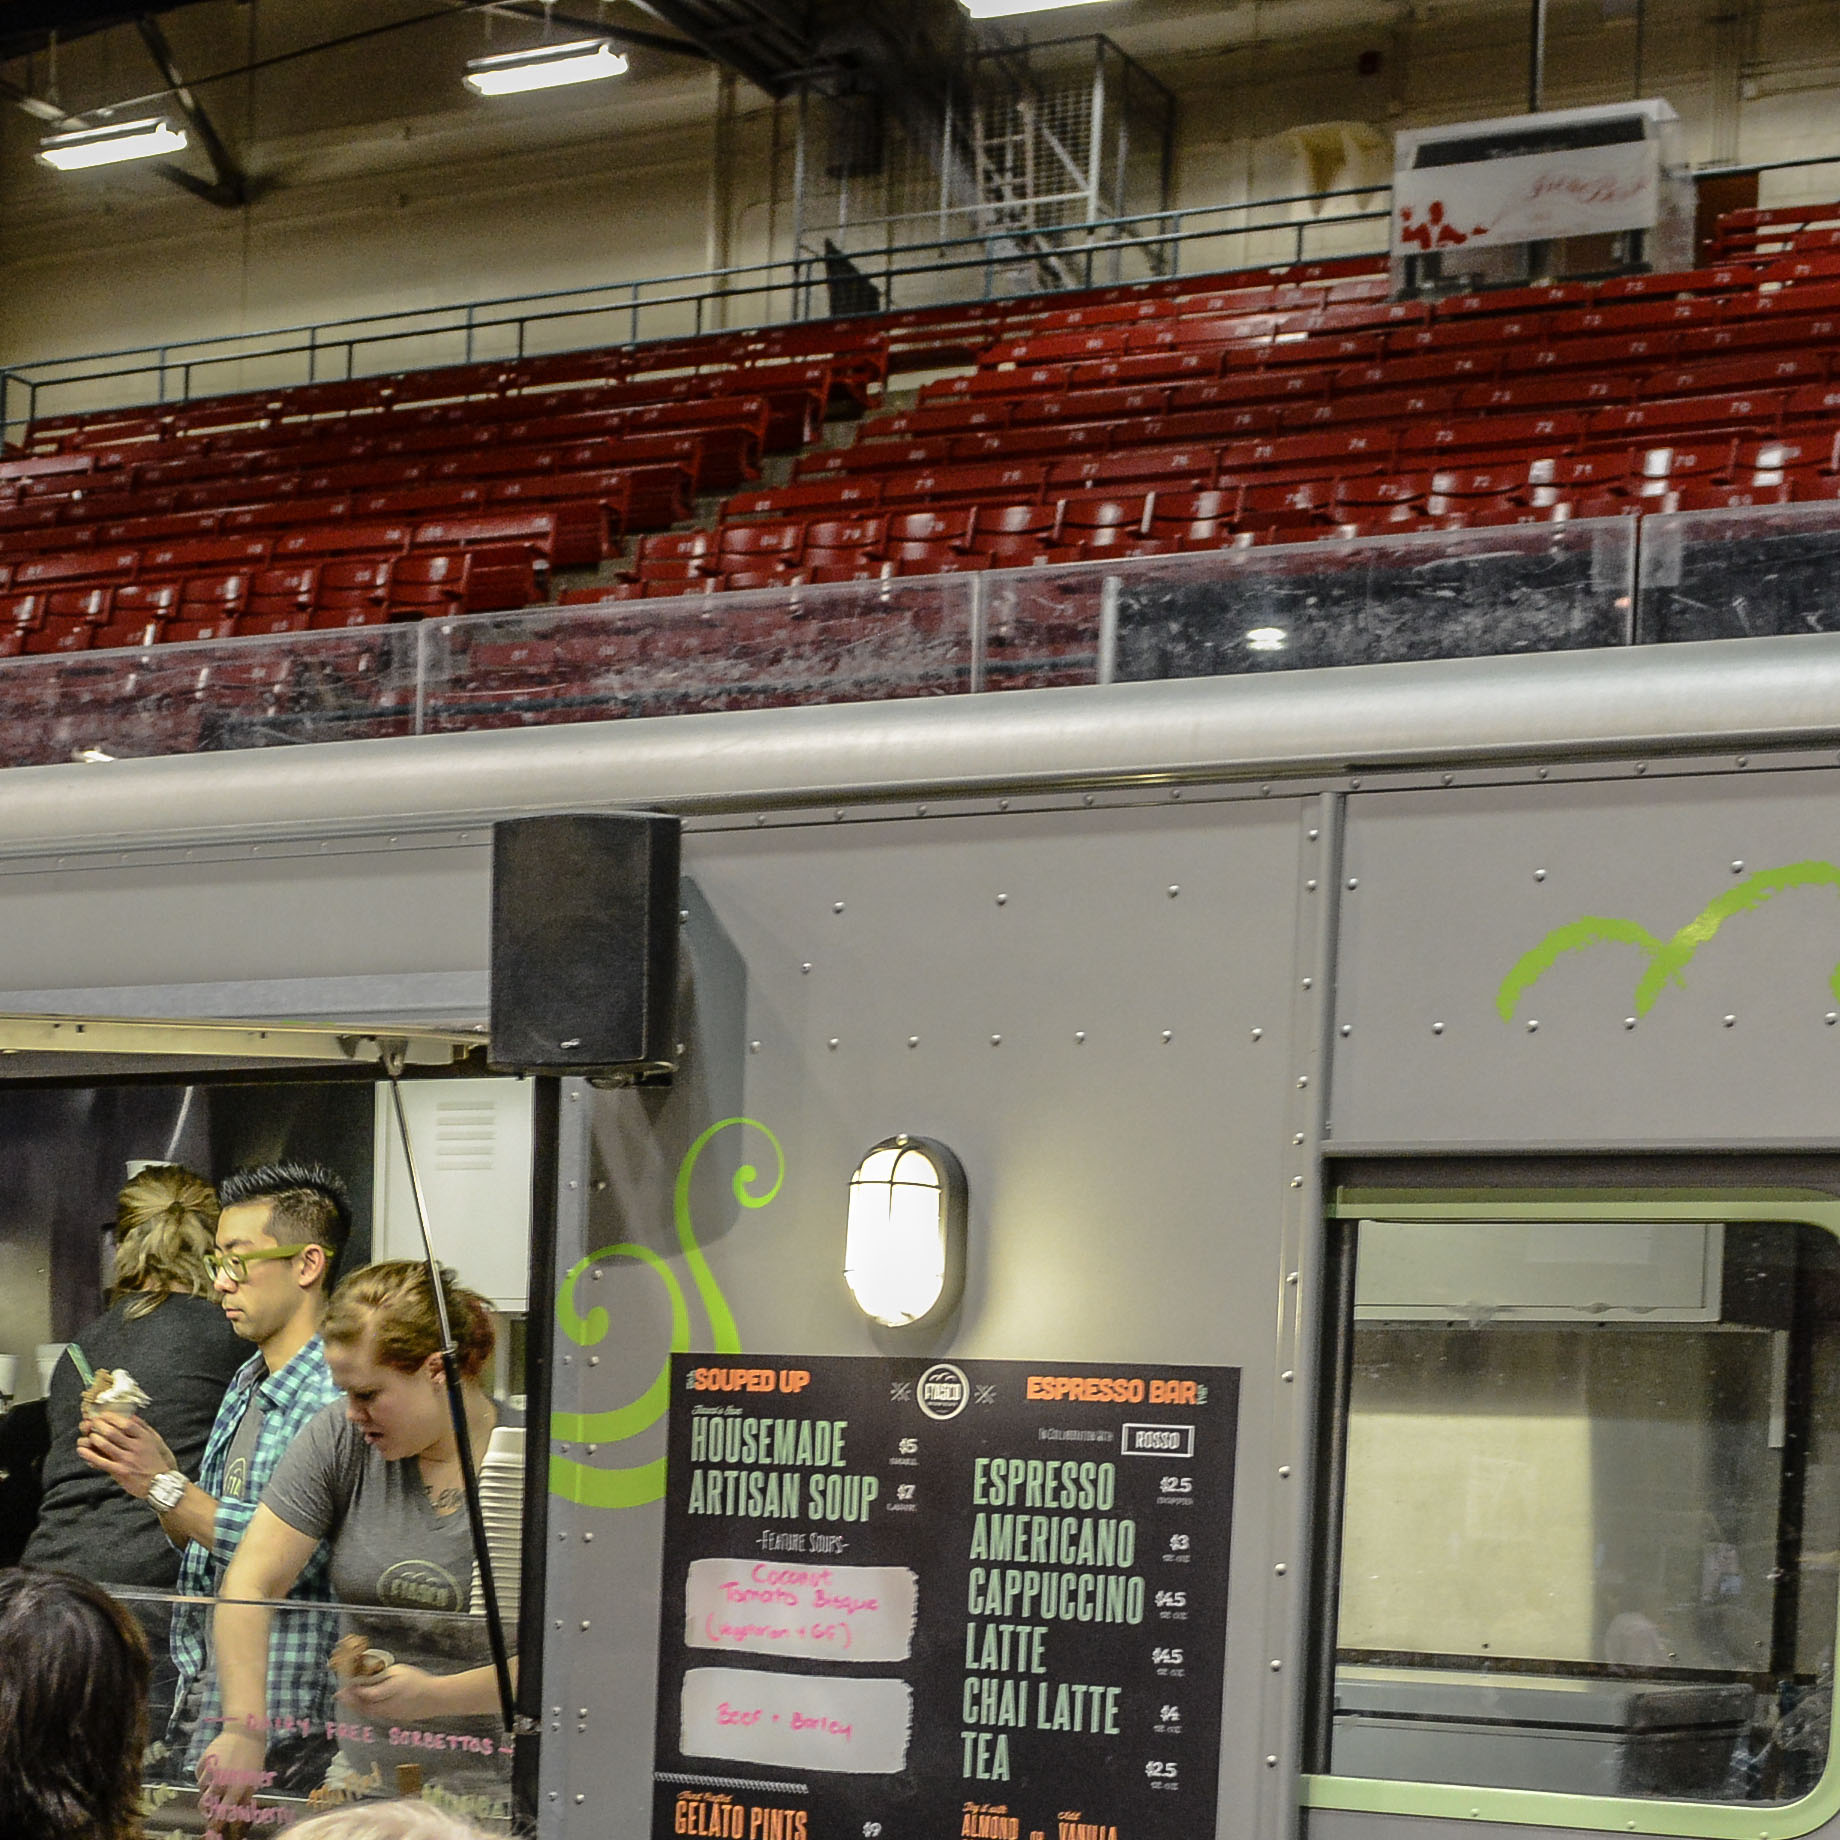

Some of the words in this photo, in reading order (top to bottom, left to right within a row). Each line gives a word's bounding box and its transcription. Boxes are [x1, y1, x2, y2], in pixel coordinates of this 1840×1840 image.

[694, 1367, 777, 1393] SOUPED
[778, 1369, 811, 1394] UP
[1026, 1376, 1146, 1404] ESPRESSO
[1148, 1379, 1199, 1406] BAR
[690, 1415, 849, 1468] HOUSEMADE
[898, 1437, 920, 1455] $5
[1134, 1430, 1182, 1450] ROSSO
[687, 1468, 802, 1519] ARTISAN
[808, 1473, 881, 1523] SOUP
[973, 1457, 1117, 1512] ESPRESSO
[968, 1512, 1137, 1568] AMERICANO
[1169, 1533, 1191, 1552] $3
[967, 1566, 1146, 1626] CAPPUCCINO
[965, 1621, 1049, 1675] LATTE
[962, 1676, 1029, 1729] CHAI
[1036, 1681, 1123, 1735] LATTE
[325, 1720, 376, 1745] FREE
[388, 1726, 494, 1757] SORBETTOS
[790, 1711, 854, 1744] Barley
[960, 1730, 1011, 1782] TEA
[674, 1800, 746, 1840] GELATO
[862, 1821, 883, 1839] $9
